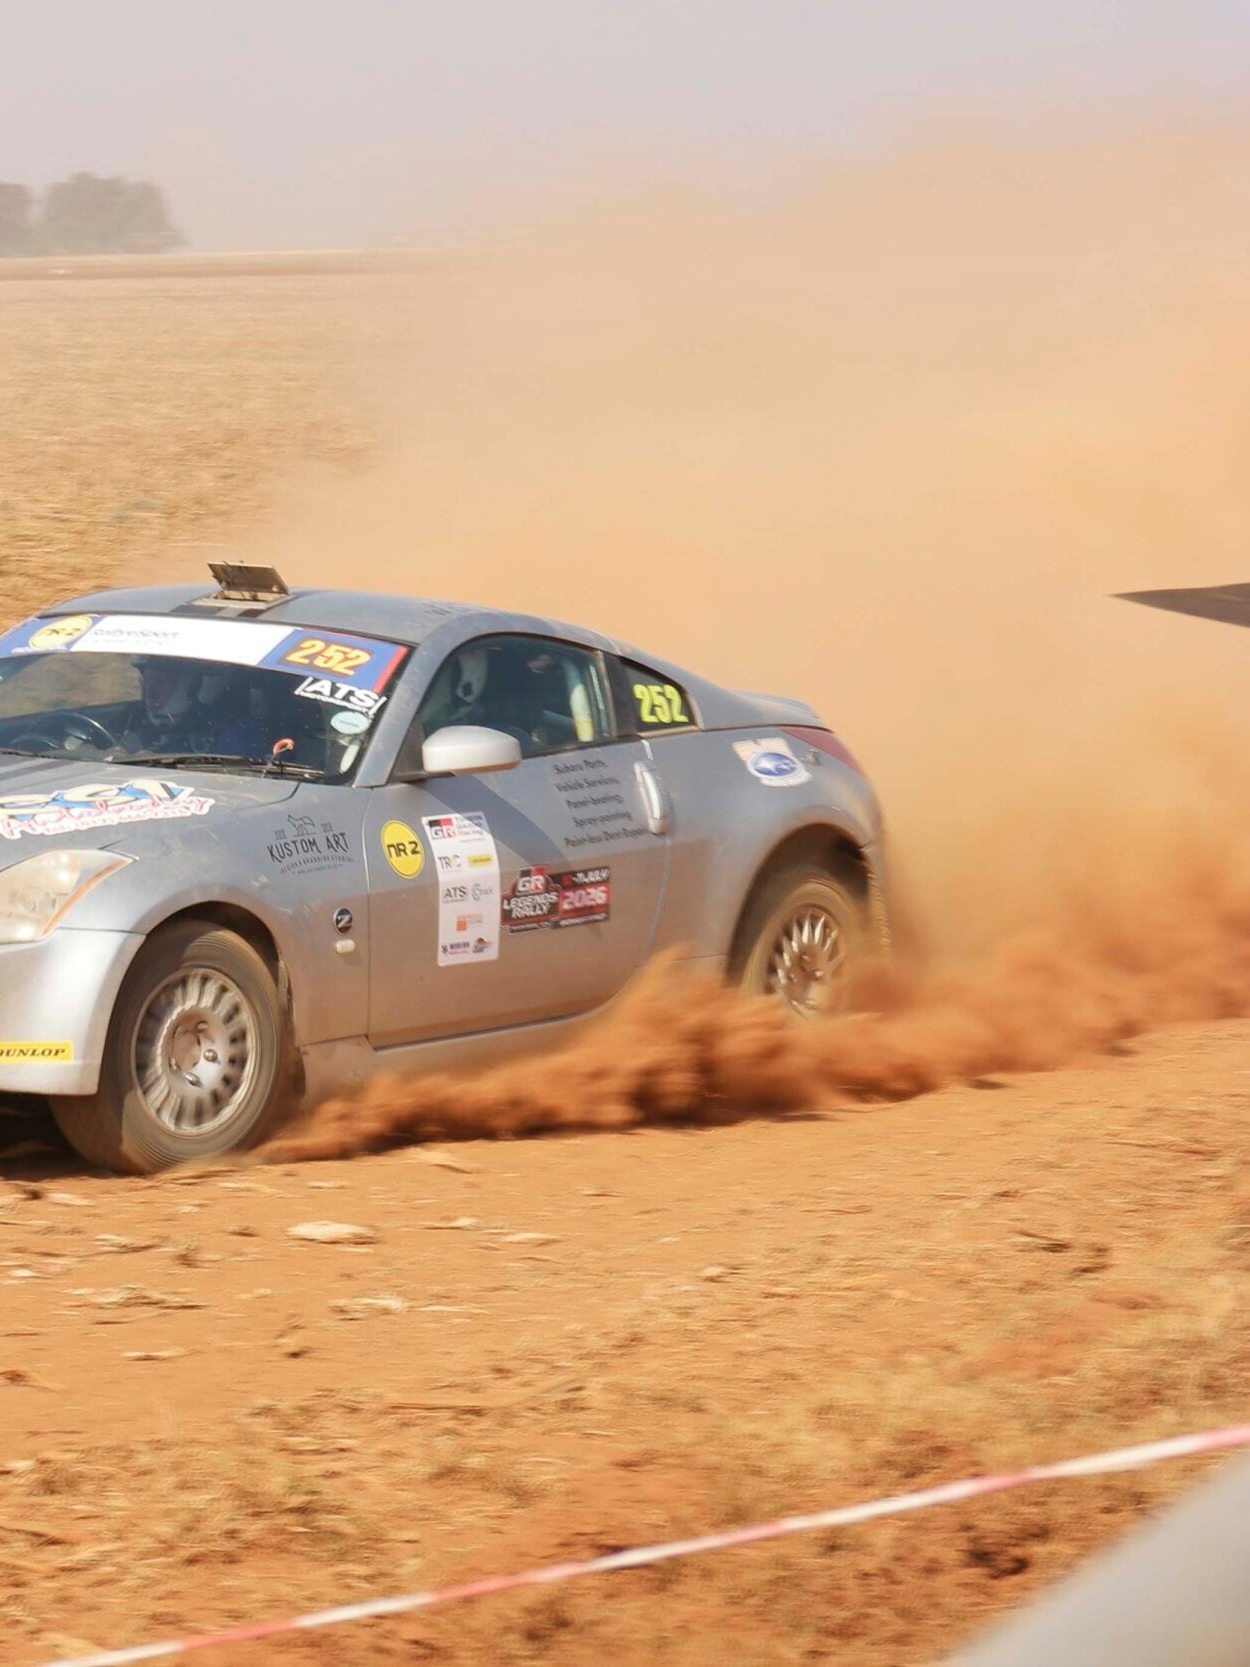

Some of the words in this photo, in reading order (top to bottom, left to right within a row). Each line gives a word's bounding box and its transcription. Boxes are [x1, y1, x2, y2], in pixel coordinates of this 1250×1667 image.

[285, 638, 372, 676] 252
[303, 679, 380, 708] ATS
[633, 683, 689, 724] 252
[430, 825, 457, 840] GR
[266, 836, 323, 863] KUSTOM
[325, 832, 350, 853] ART
[444, 885, 468, 899] ATS
[517, 875, 546, 892] GR
[503, 891, 559, 910] LEGENDS
[511, 902, 551, 919] RALLY
